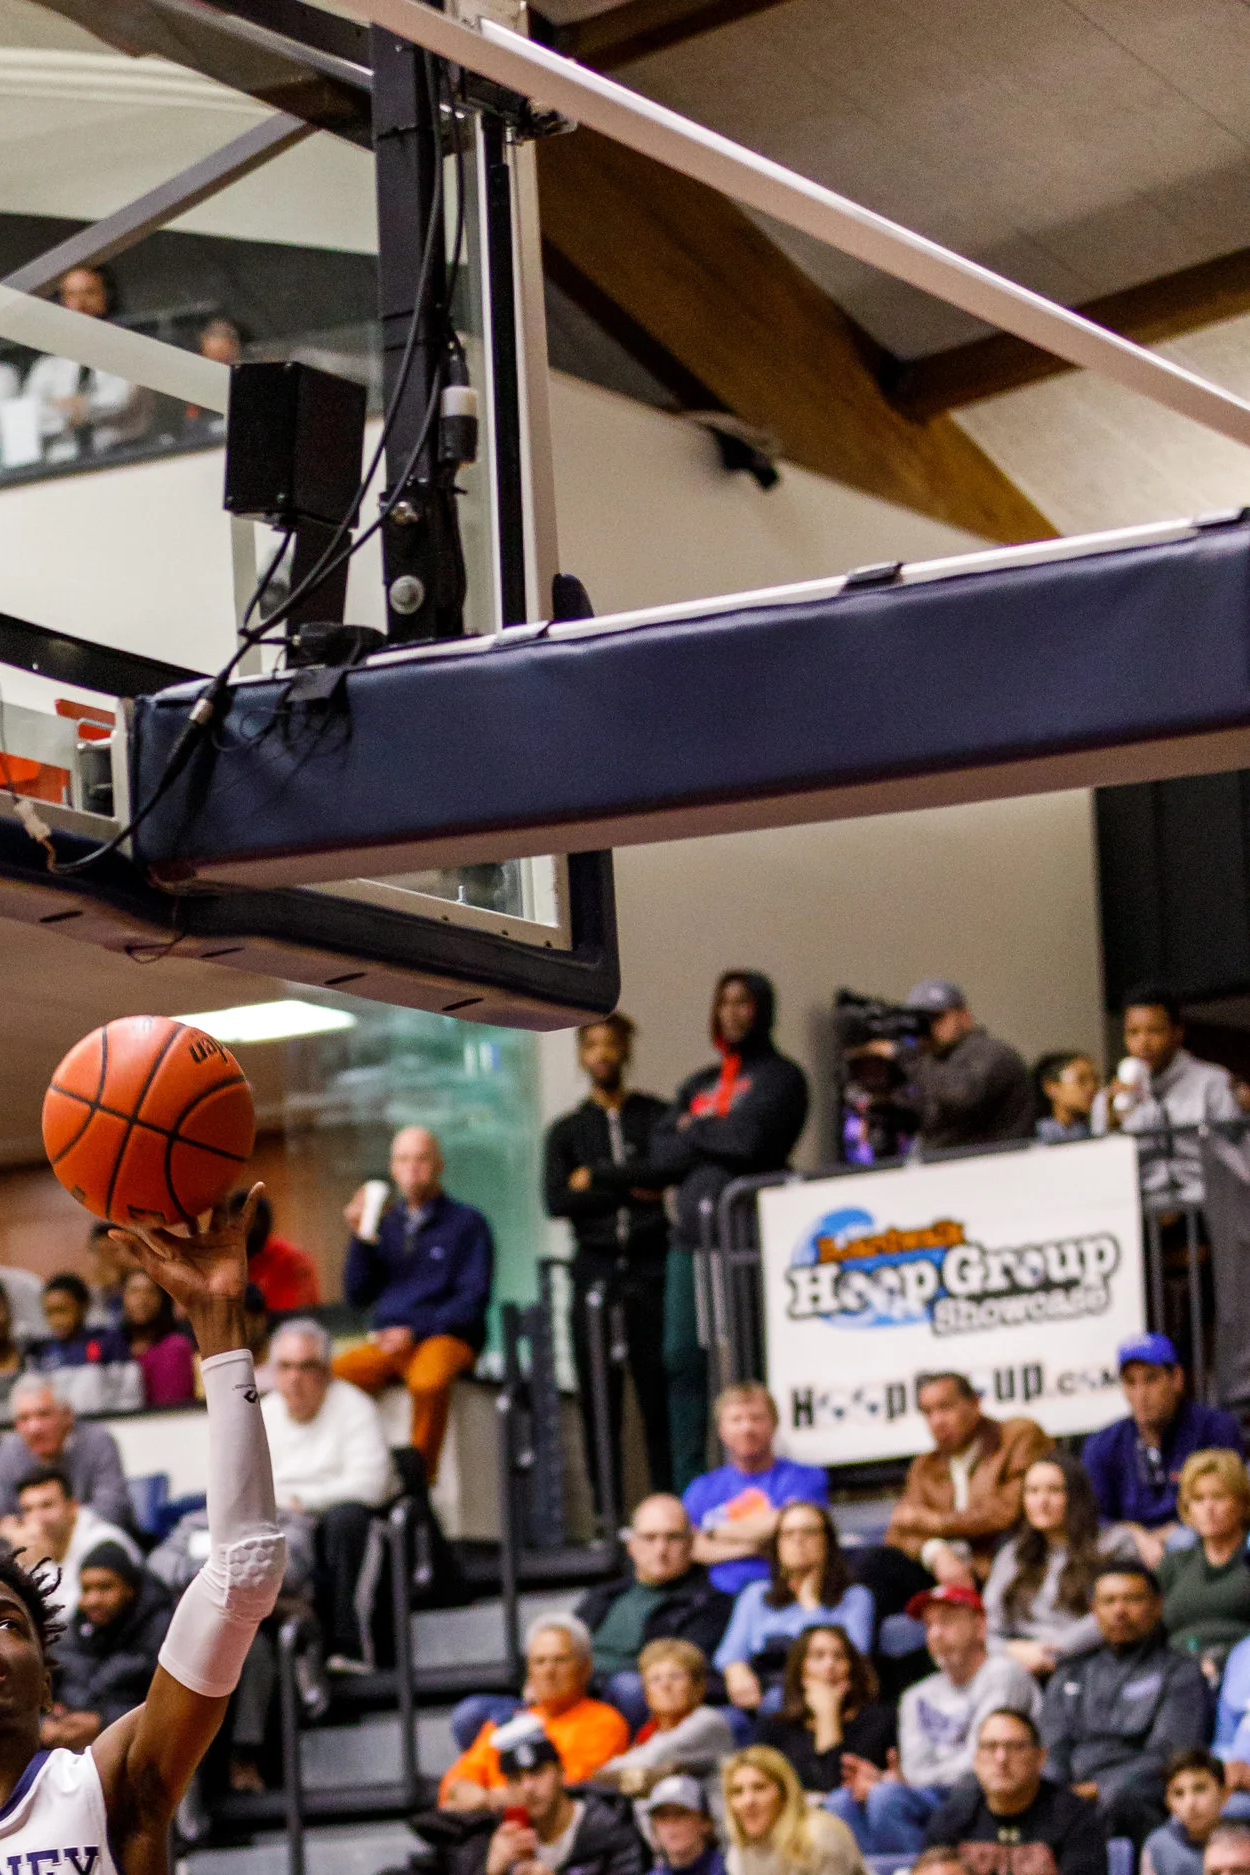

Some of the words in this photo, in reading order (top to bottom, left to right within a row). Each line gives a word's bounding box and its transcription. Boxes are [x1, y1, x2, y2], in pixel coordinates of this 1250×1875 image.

[789, 1259, 940, 1319] Hoop
[943, 1234, 1119, 1297] Group
[934, 1286, 1109, 1336] Showcase
